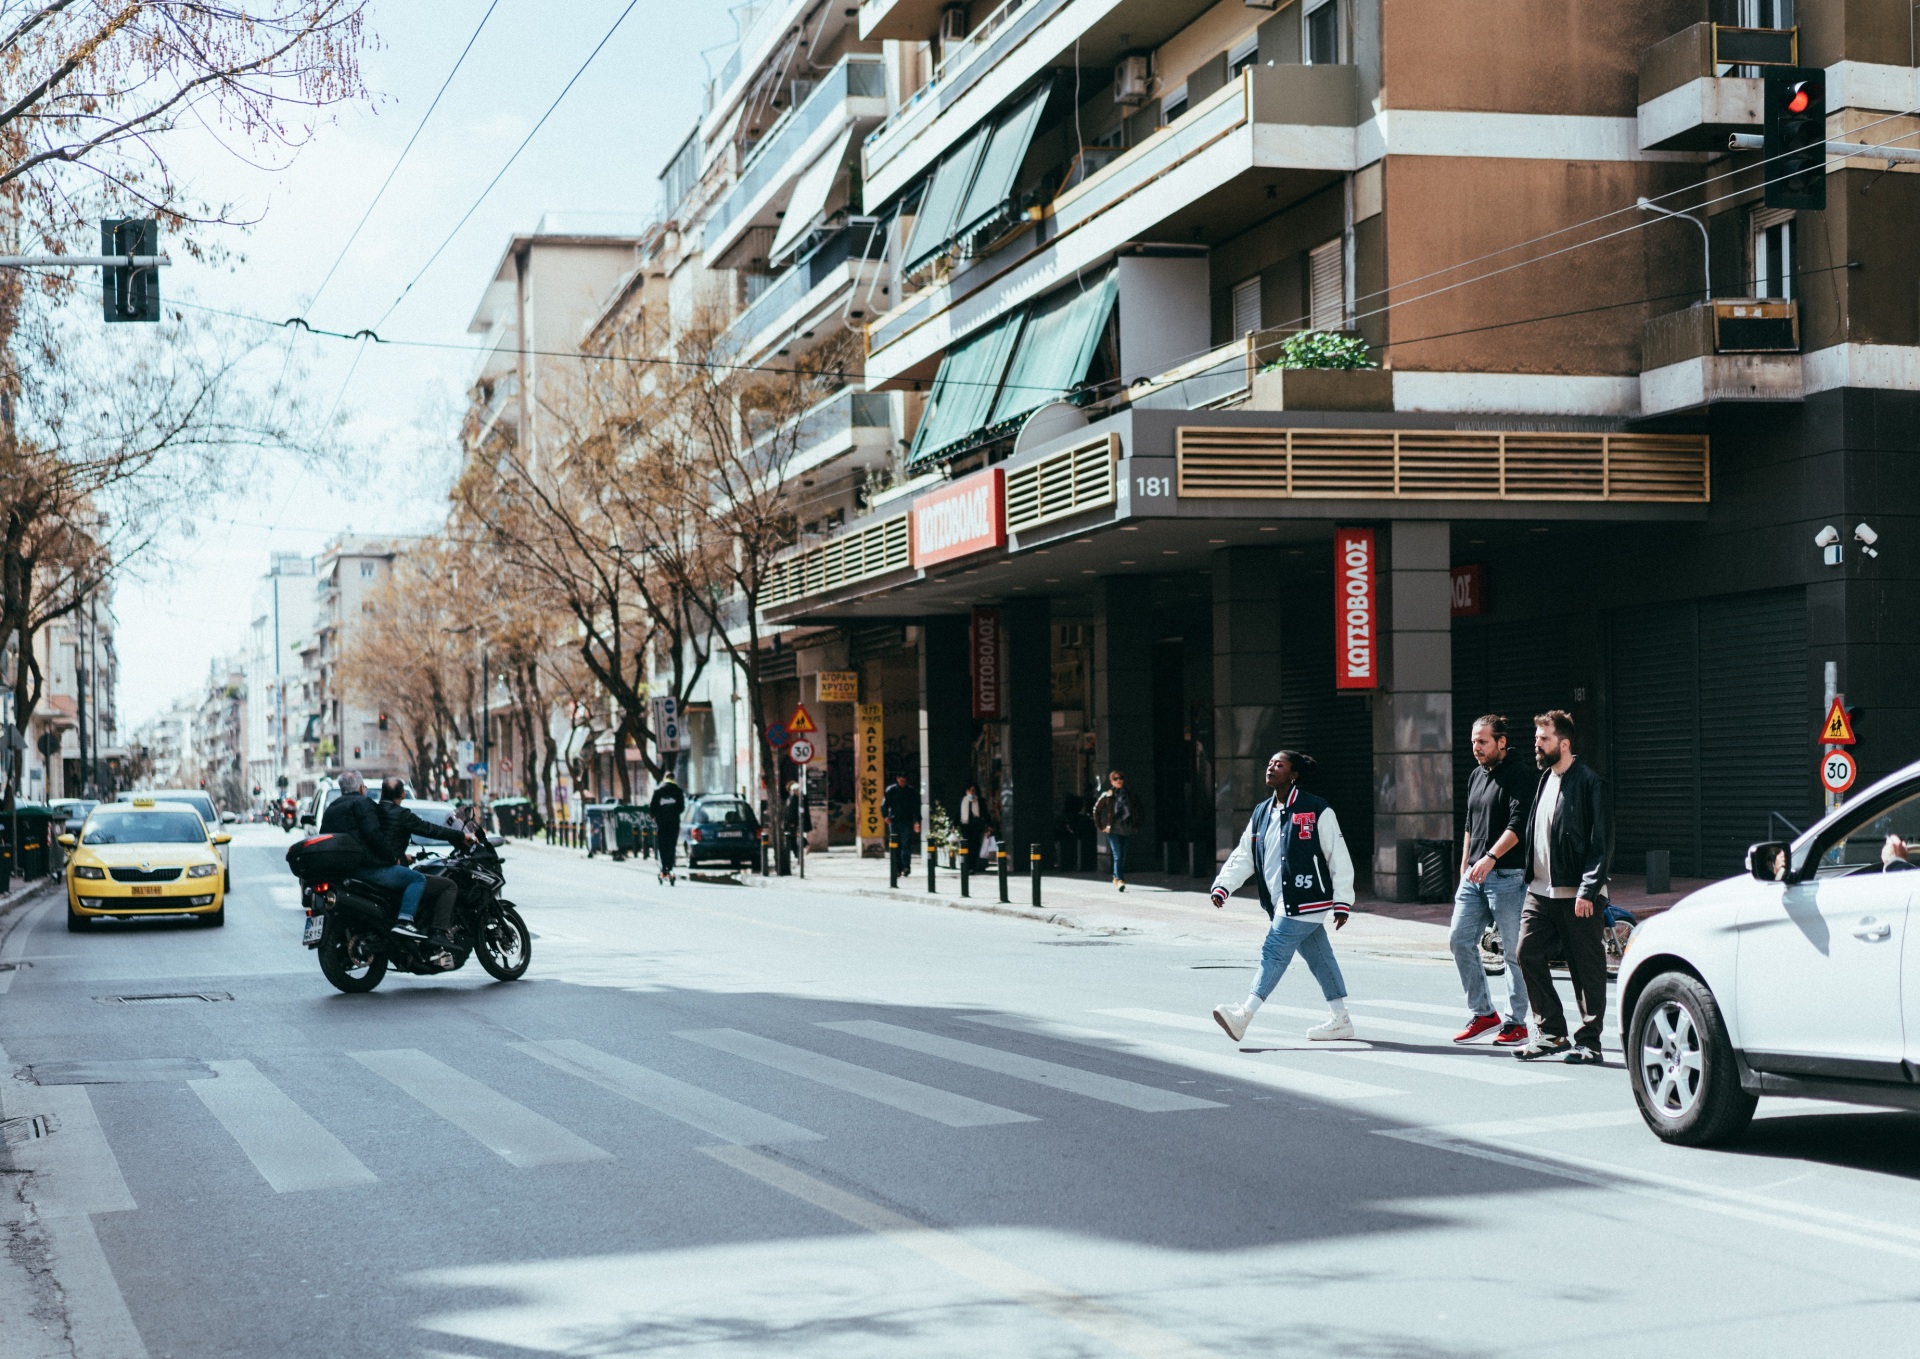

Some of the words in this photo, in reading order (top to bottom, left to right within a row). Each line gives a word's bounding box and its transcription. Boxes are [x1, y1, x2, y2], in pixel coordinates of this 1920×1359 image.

[1136, 476, 1170, 497] 181
[1345, 539, 1371, 678] ΚΩΤΣΟΒΟΛΟΣ
[979, 617, 996, 712] ΚΩΤΣΟΒΟΛΟΣ
[821, 683, 856, 692] ΧΡΥΣΟΥ
[1573, 687, 1586, 703] 181
[794, 745, 810, 757] 30
[866, 726, 878, 773] ΑΓΟΡΑ
[1827, 762, 1848, 779] 30
[867, 778, 879, 834] ΧΡΥΣΟΥ
[1294, 874, 1313, 889] 85
